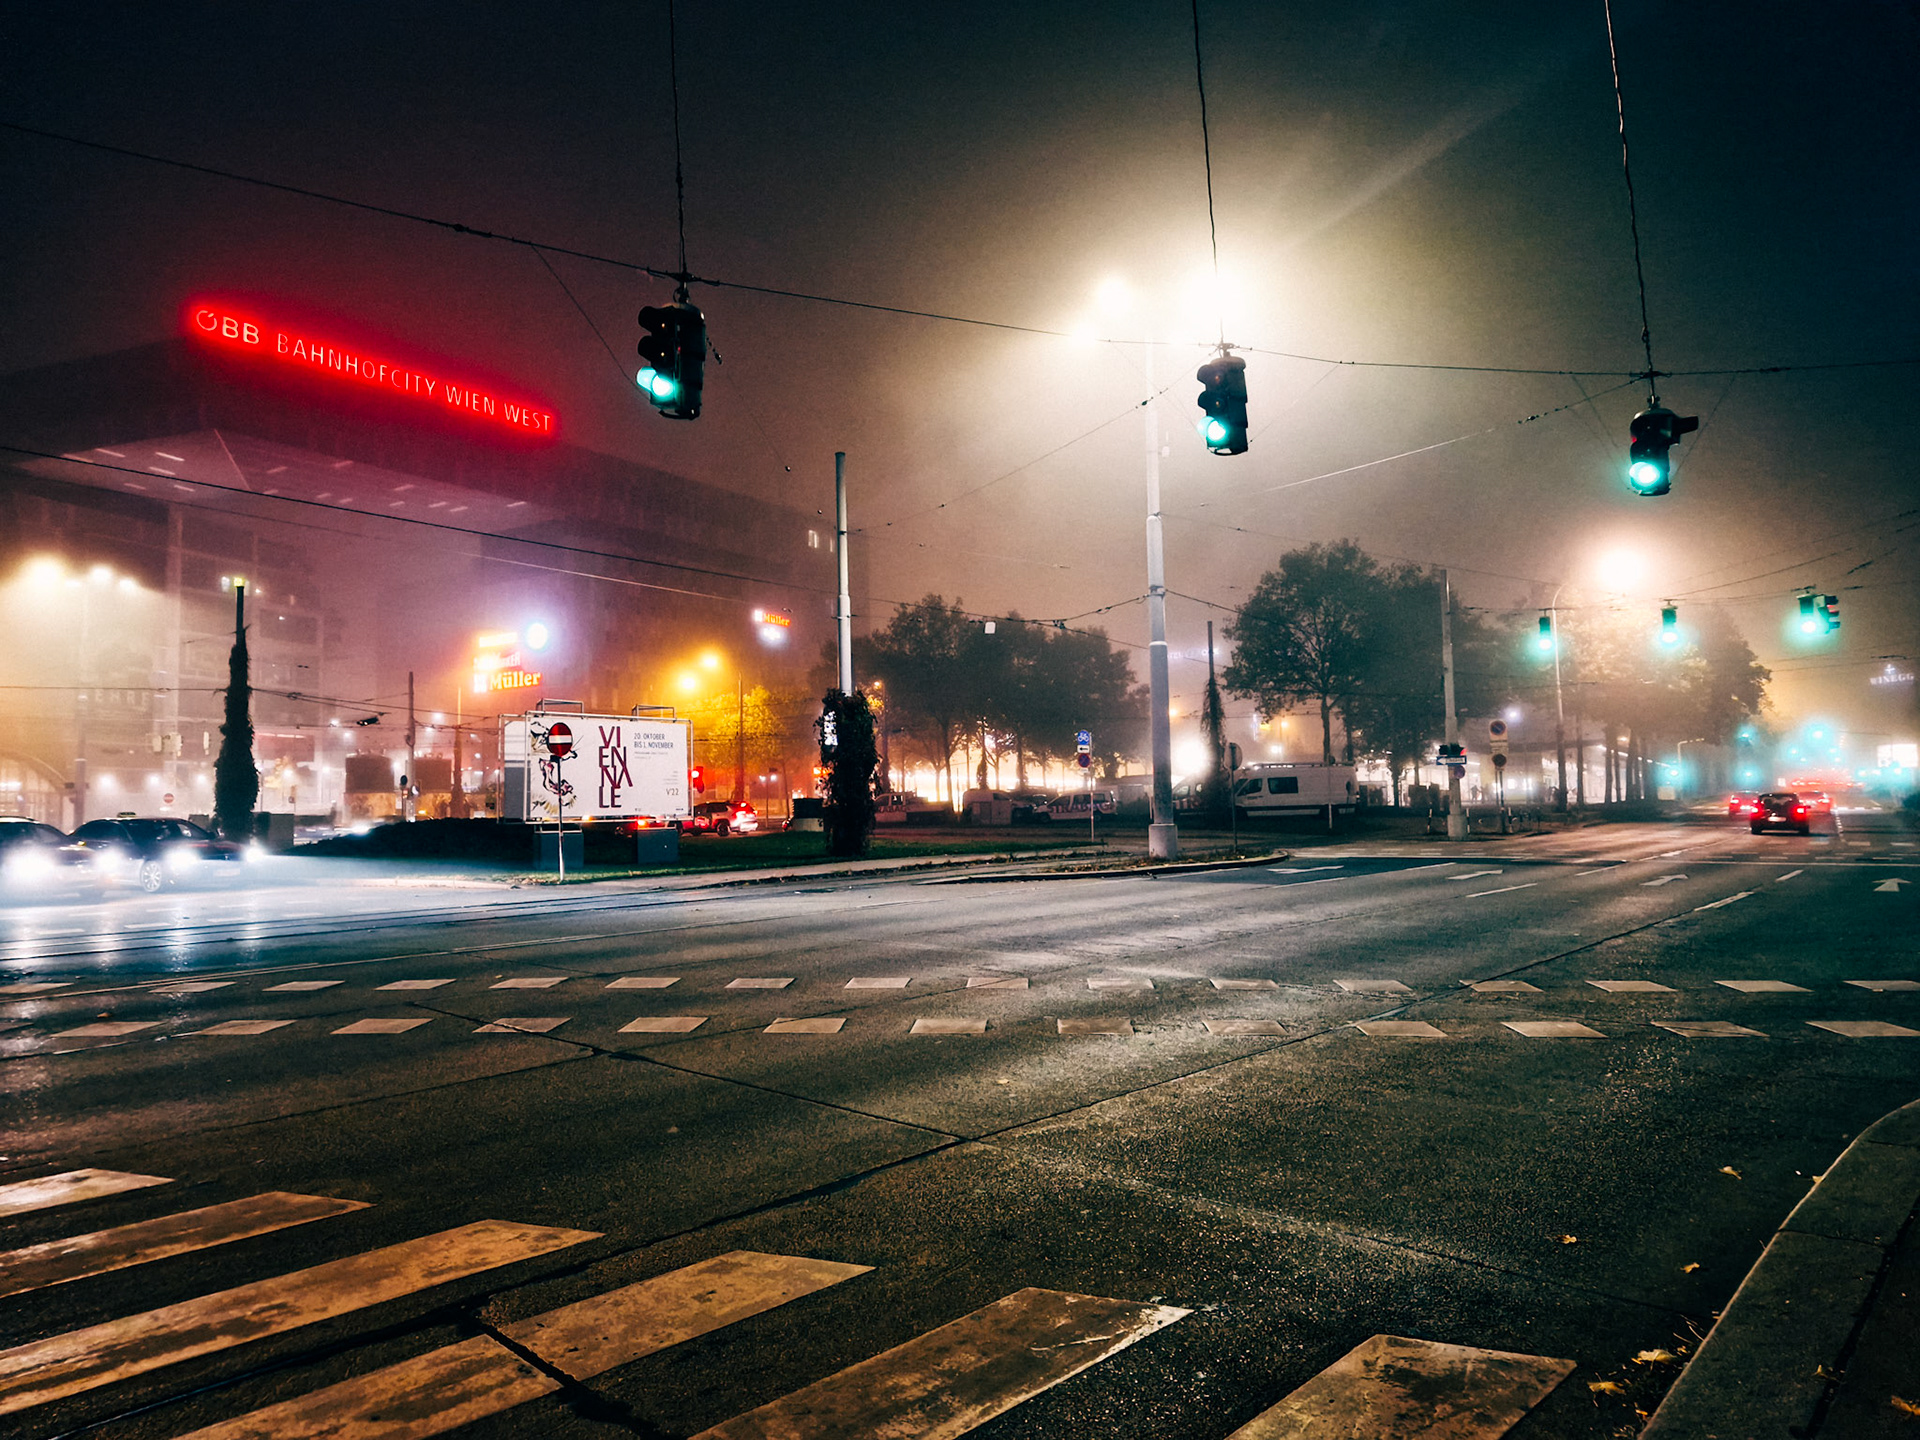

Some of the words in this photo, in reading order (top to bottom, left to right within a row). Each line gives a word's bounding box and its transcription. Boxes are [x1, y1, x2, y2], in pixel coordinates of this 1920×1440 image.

[196, 310, 259, 344] ÖBB
[277, 333, 436, 396] BAHNHOFCITY
[445, 384, 495, 415] WIEN
[504, 402, 551, 431] WEST
[489, 670, 541, 691] Müller
[634, 741, 642, 749] BIS
